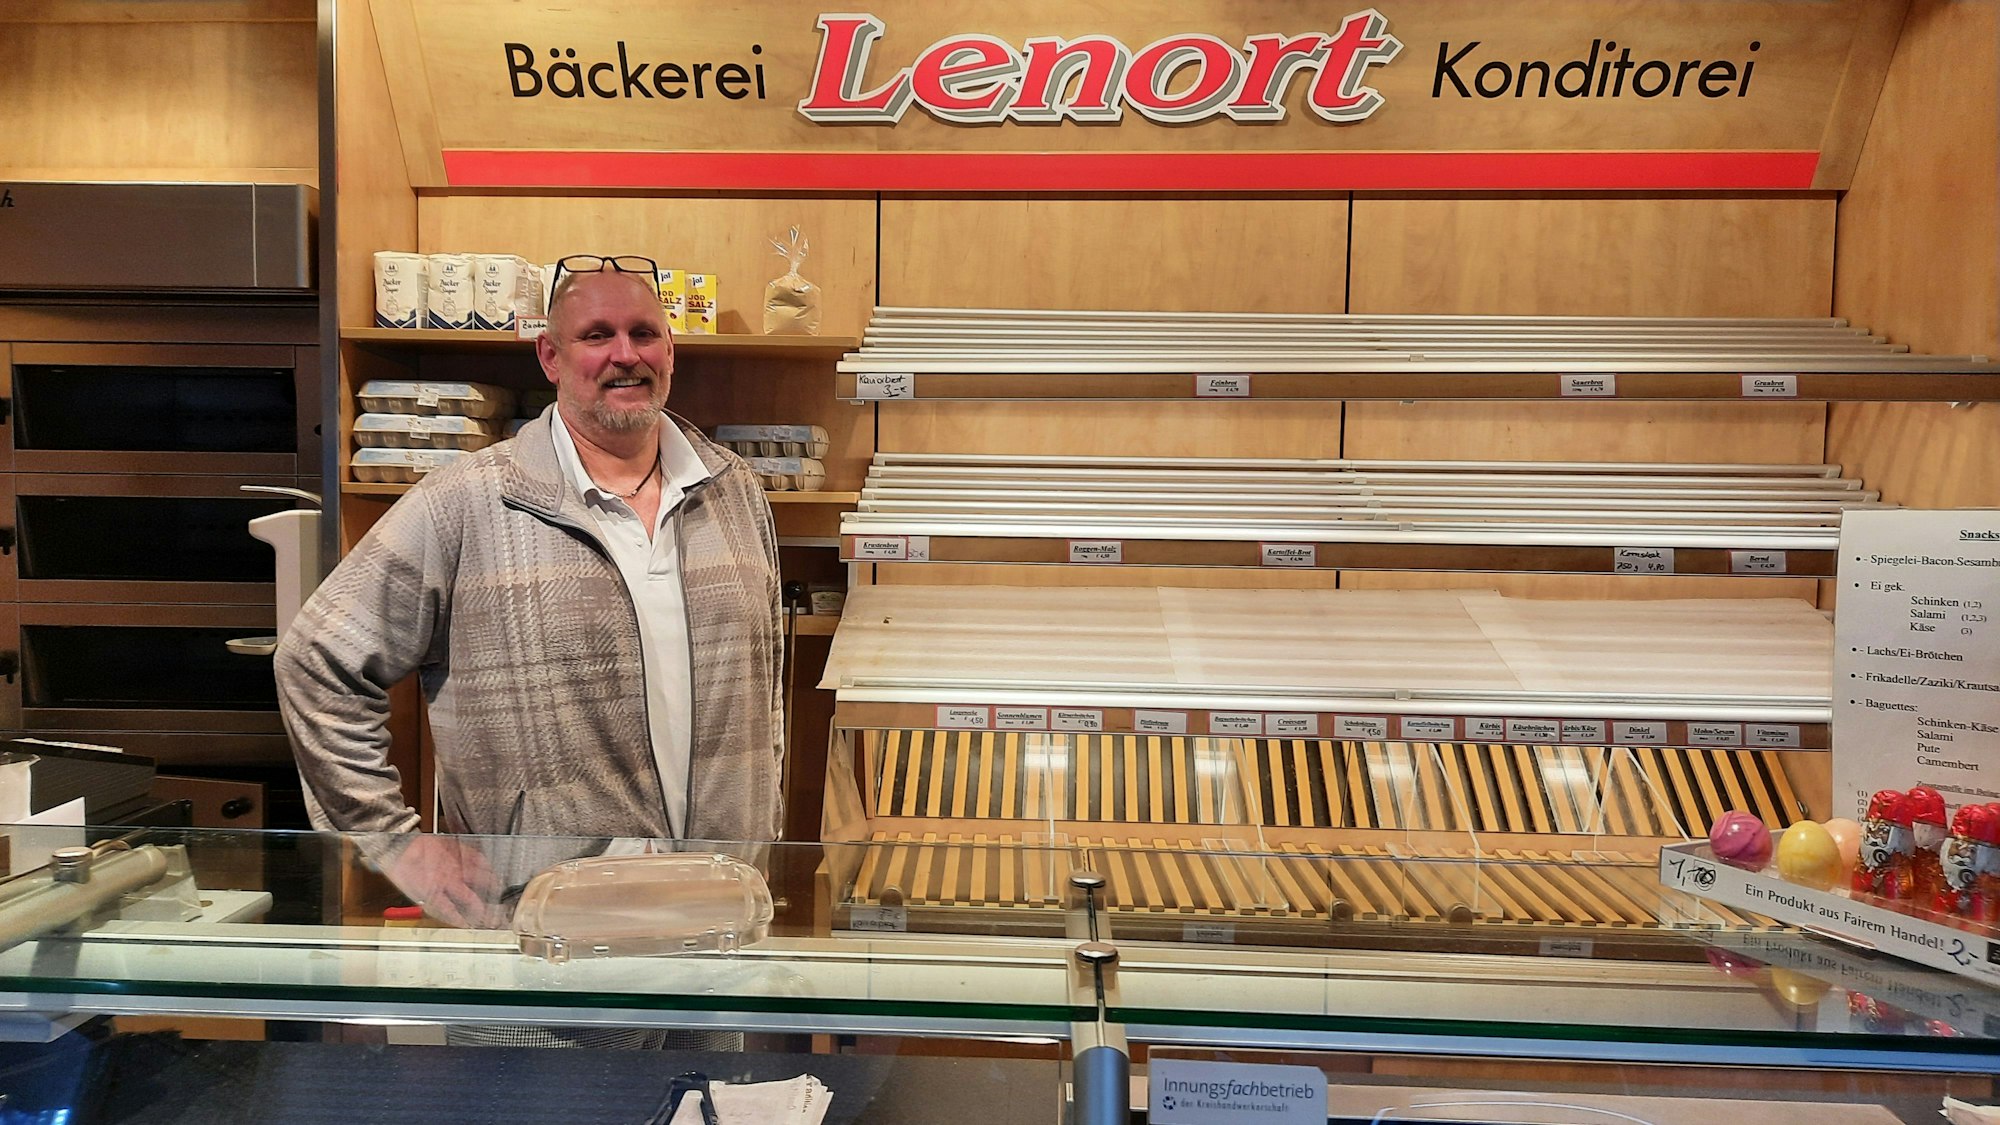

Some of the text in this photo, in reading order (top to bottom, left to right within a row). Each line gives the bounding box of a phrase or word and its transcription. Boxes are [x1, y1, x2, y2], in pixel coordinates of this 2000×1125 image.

[504, 41, 766, 99] Bäckerei
[799, 9, 1404, 122] Lenort
[1431, 39, 1760, 98] Konditorei
[382, 278, 400, 286] Zucker
[440, 279, 460, 287] Zucker
[482, 279, 501, 287] Zucker
[1871, 581, 1905, 592] Ei gek.
[1911, 596, 1959, 608] Schinken
[1910, 609, 1946, 619] Salami
[1909, 622, 1936, 632] Käse
[1867, 646, 1963, 661] Lachs/Ei-Brötchen
[1865, 699, 1918, 713] Baguettes:
[1277, 718, 1307, 726] Croissant
[1917, 717, 1999, 733] Schinken-Käse
[1629, 726, 1650, 734] Dinkel
[1917, 730, 1953, 742] Salami
[1917, 743, 1940, 754] Pute
[1917, 756, 1979, 771] Camembert
[1745, 883, 1944, 950] Ein Produkt aus Fairem Handel!
[1163, 1077, 1314, 1100] Innungsfachbetrieb
[1180, 1099, 1288, 1113] der Kreishandwerkerschaft
